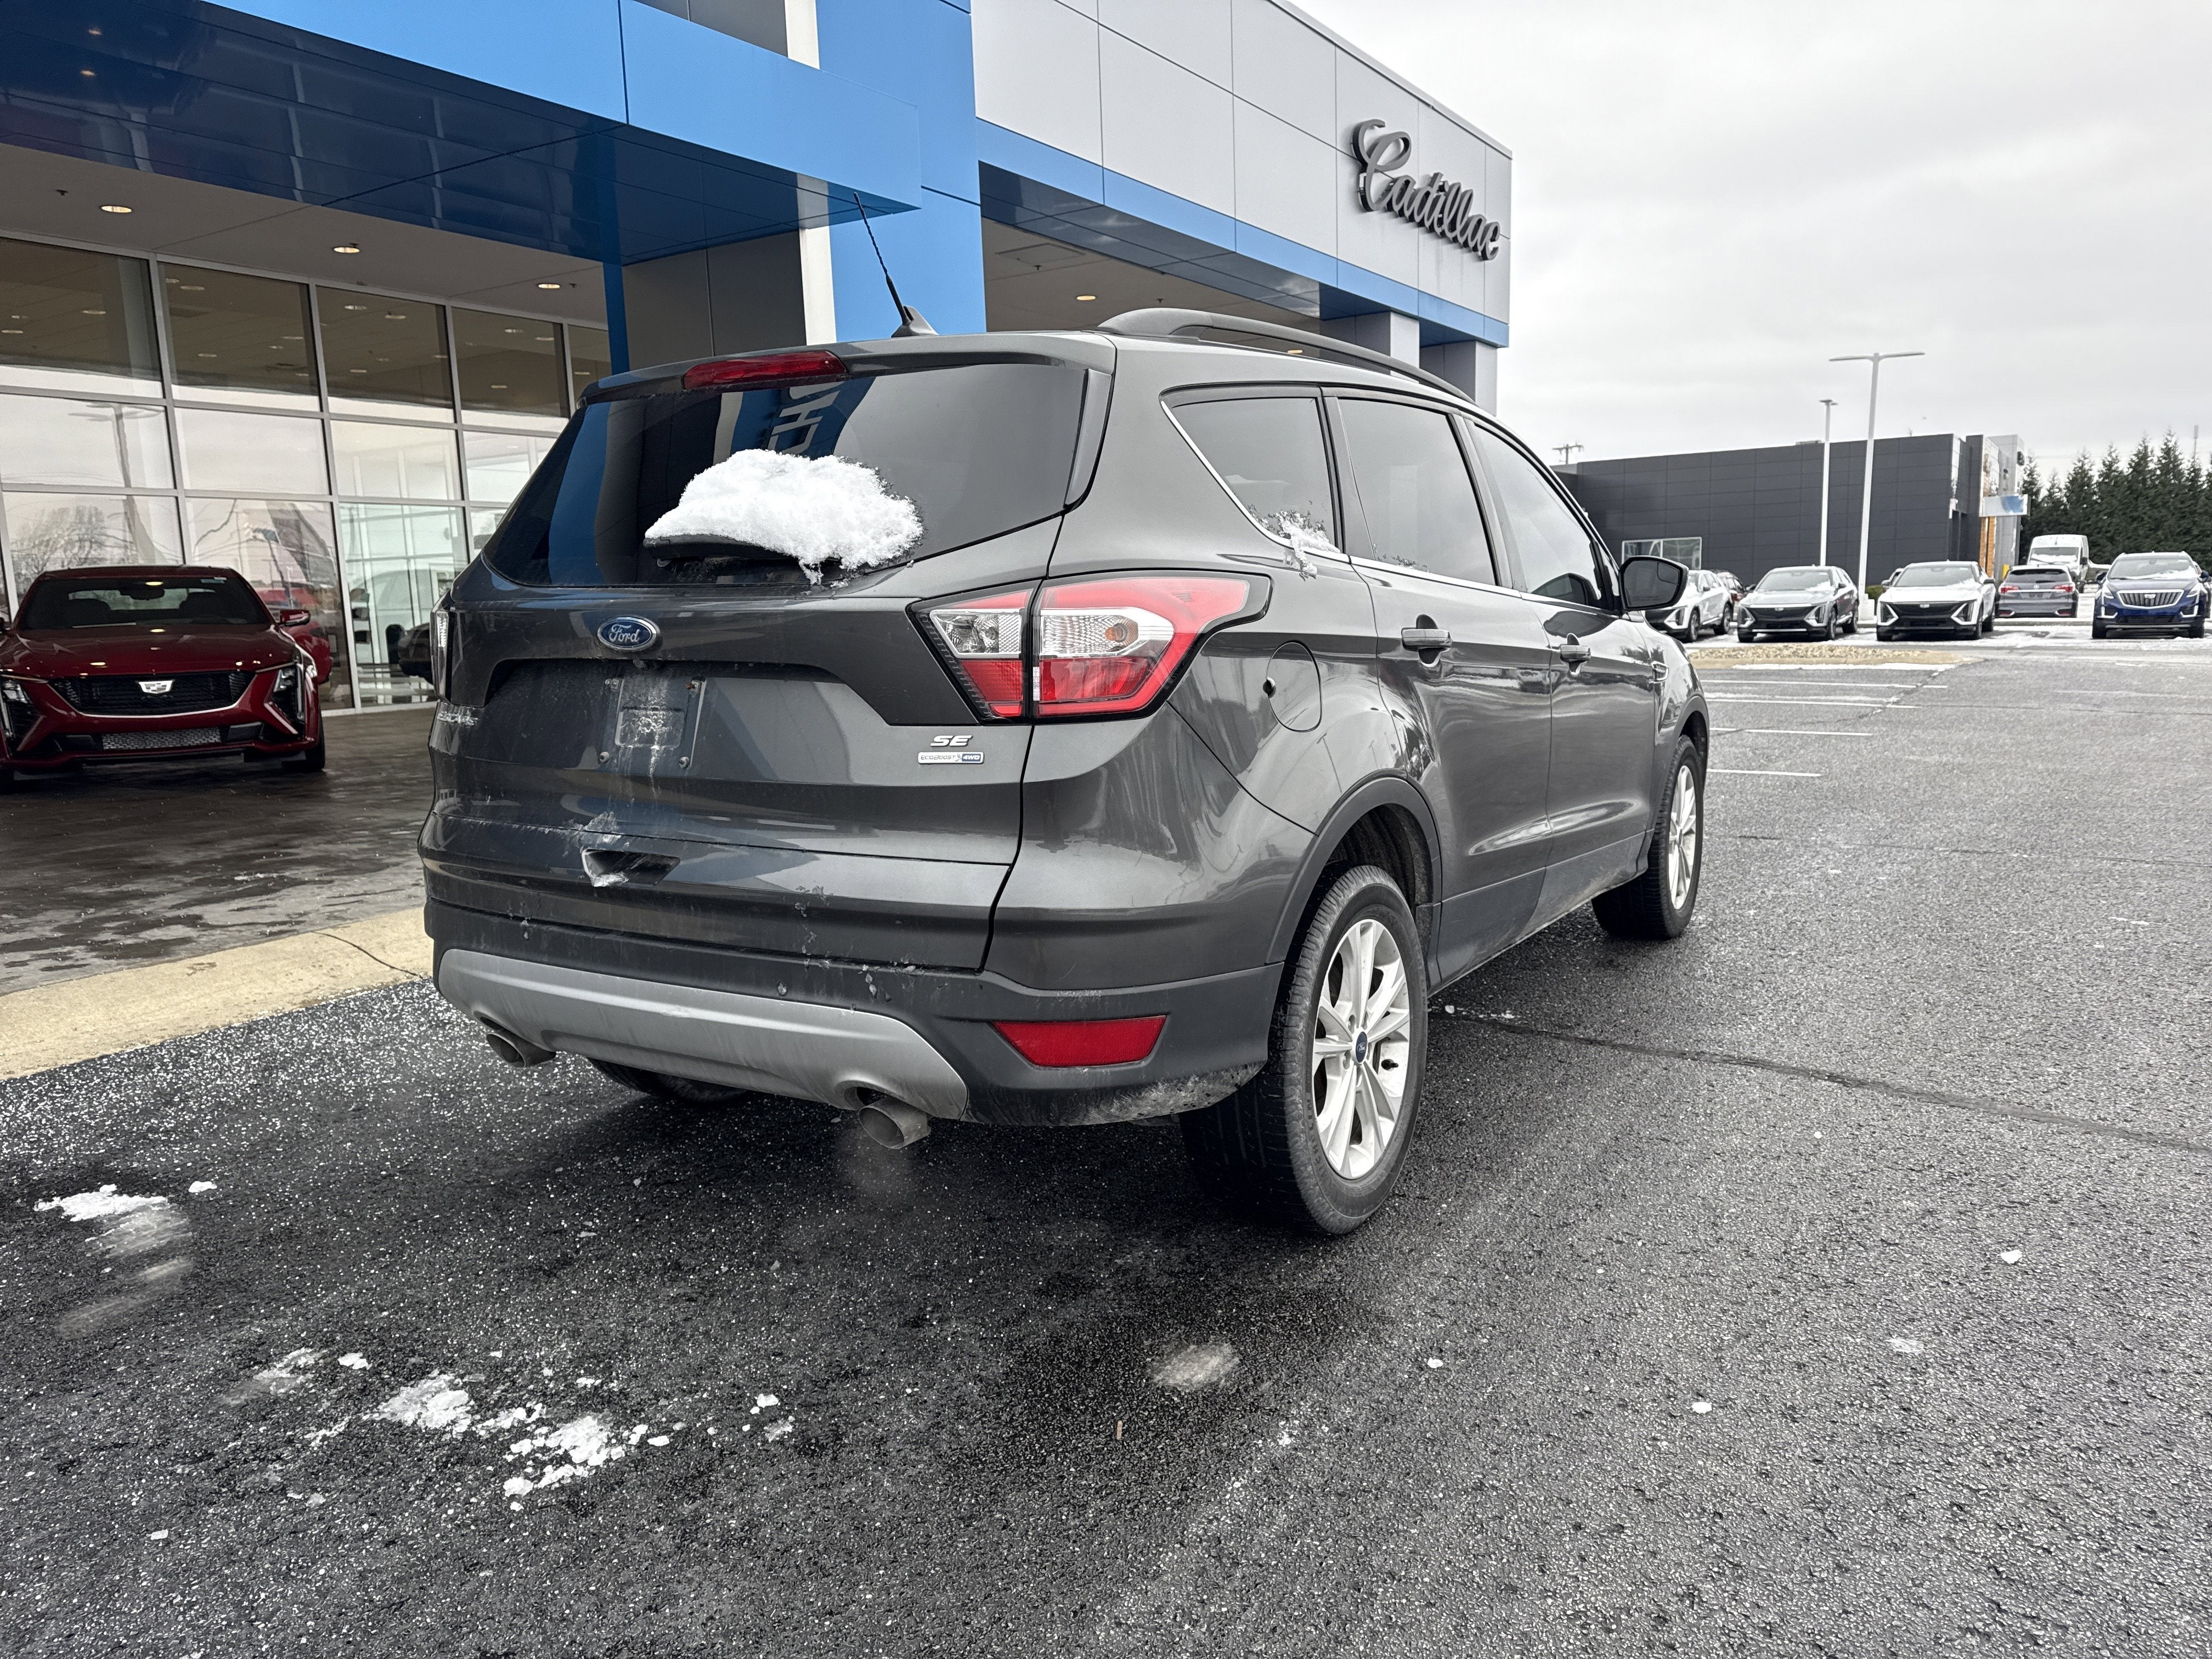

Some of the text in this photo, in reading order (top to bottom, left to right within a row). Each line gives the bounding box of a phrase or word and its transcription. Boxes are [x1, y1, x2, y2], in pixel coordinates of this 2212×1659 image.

[1352, 119, 1500, 261] Cadillac
[608, 624, 641, 643] Ford
[930, 735, 973, 747] SE
